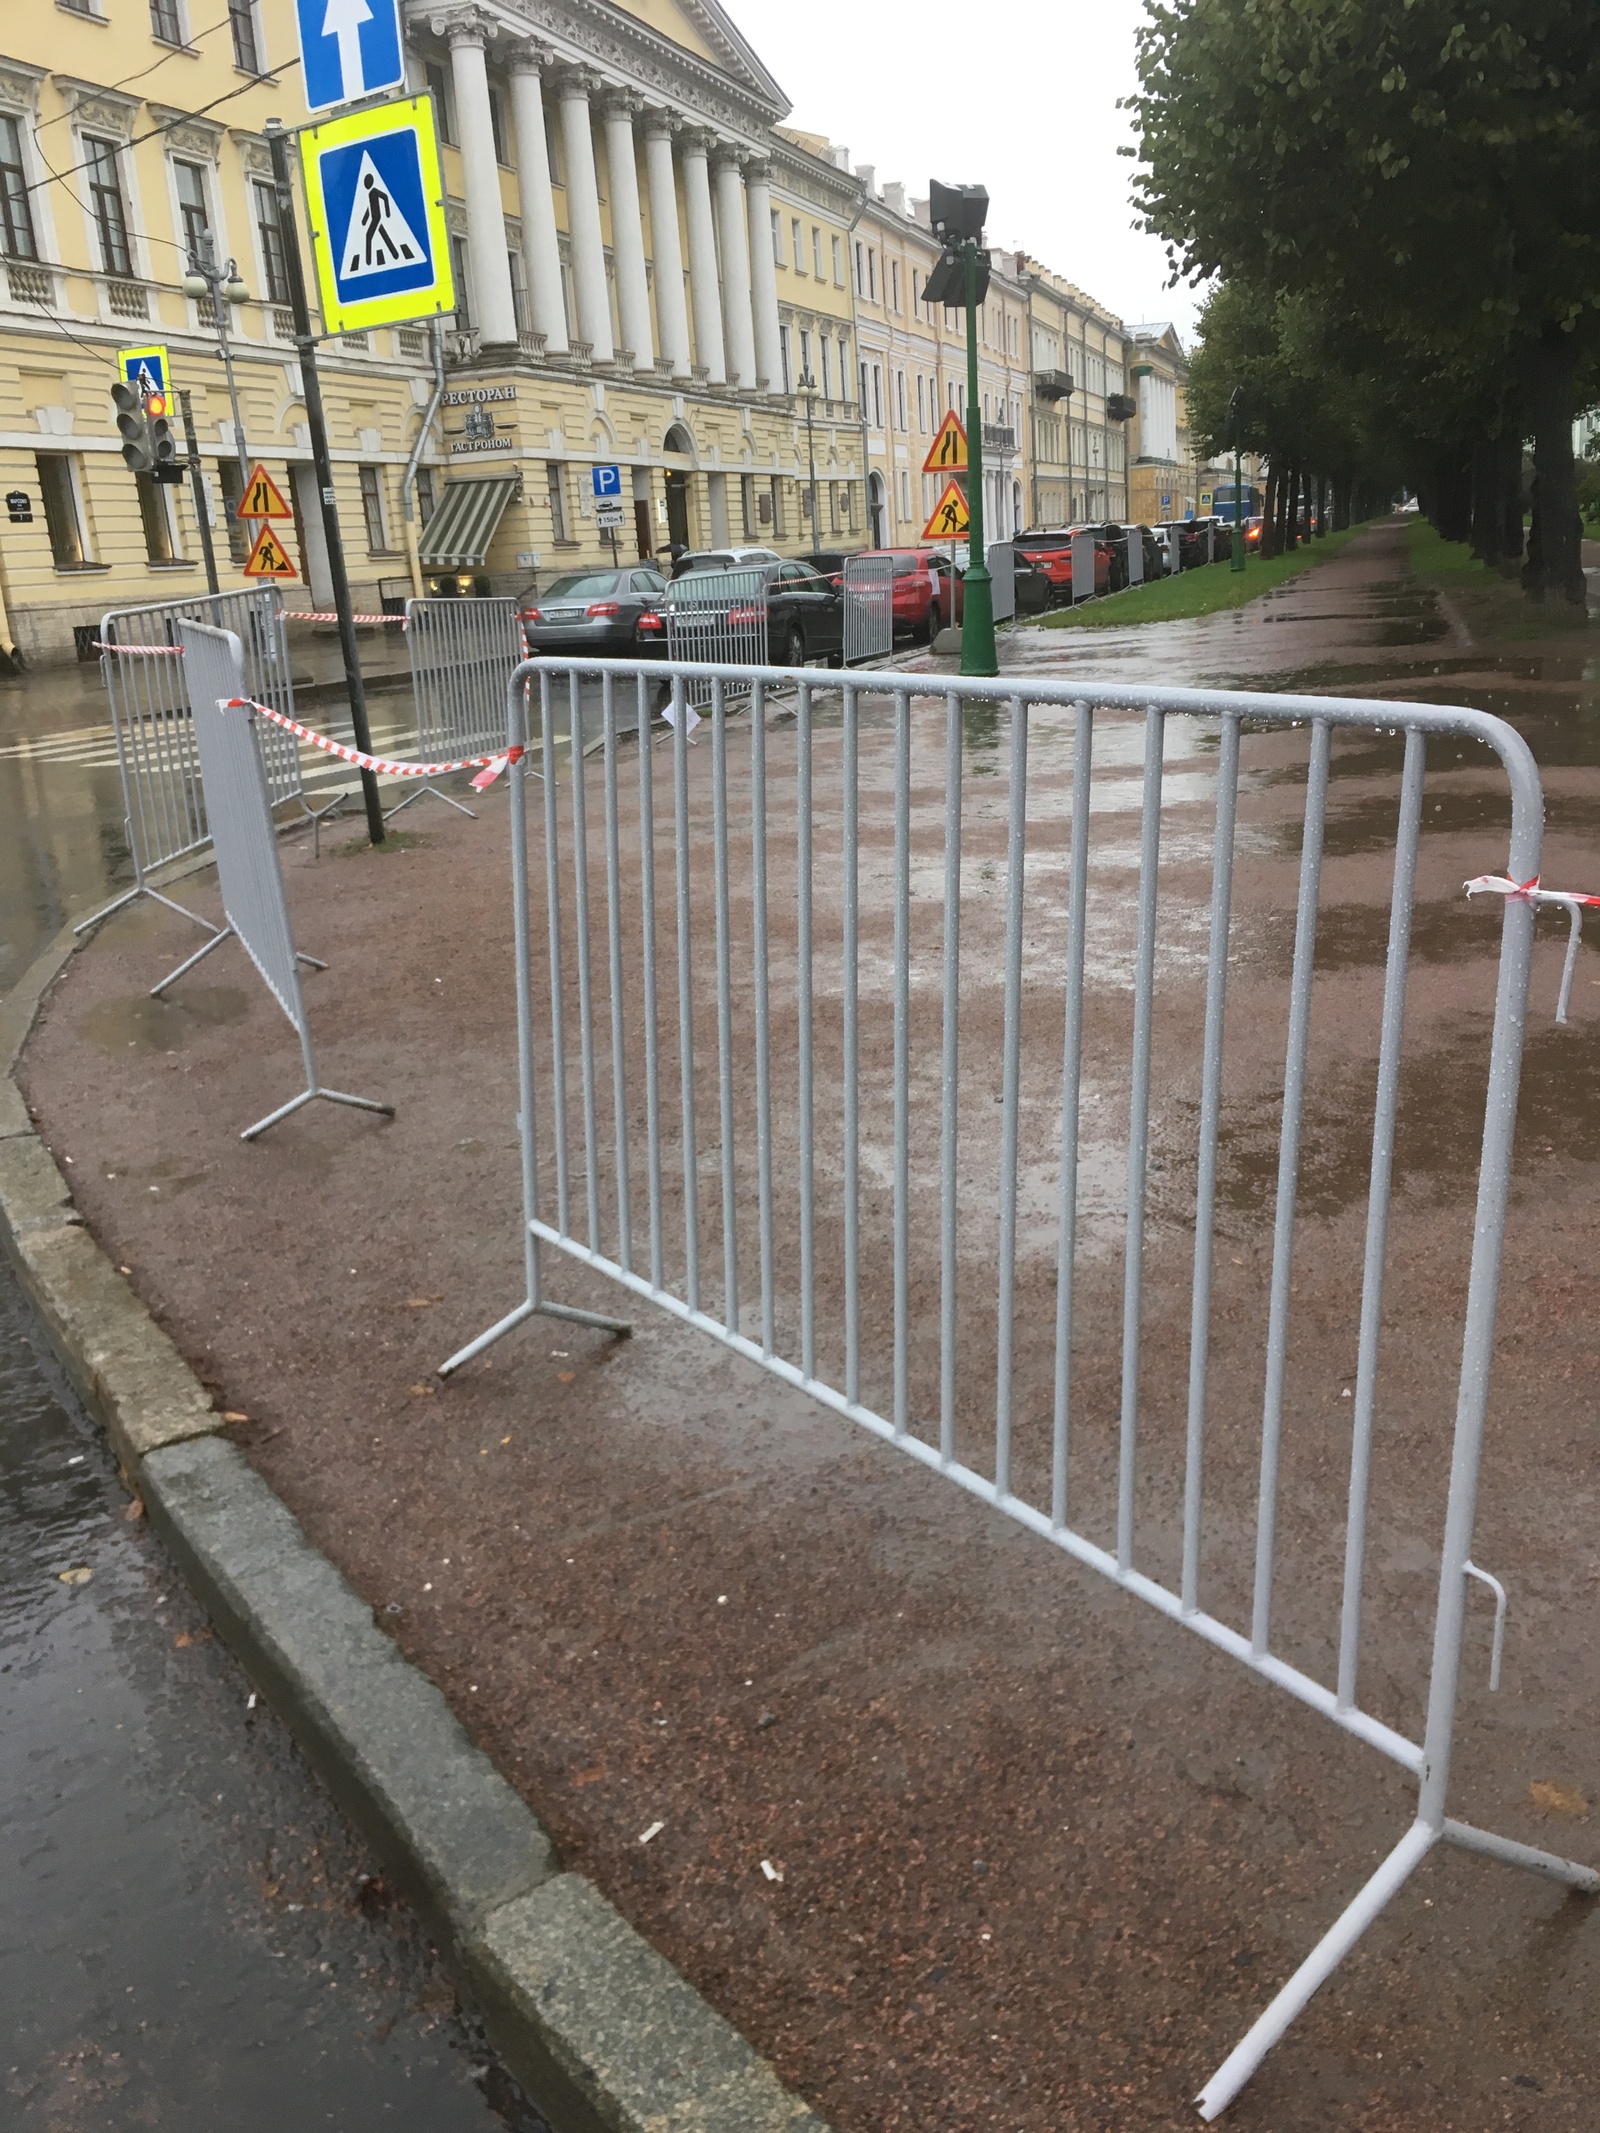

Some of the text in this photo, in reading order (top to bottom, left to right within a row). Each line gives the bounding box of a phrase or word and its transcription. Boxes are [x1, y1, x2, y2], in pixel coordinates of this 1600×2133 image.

[441, 386, 516, 406] РЕСТОРАН
[450, 438, 512, 452] ГАСТРОНОМ
[599, 469, 615, 493] P
